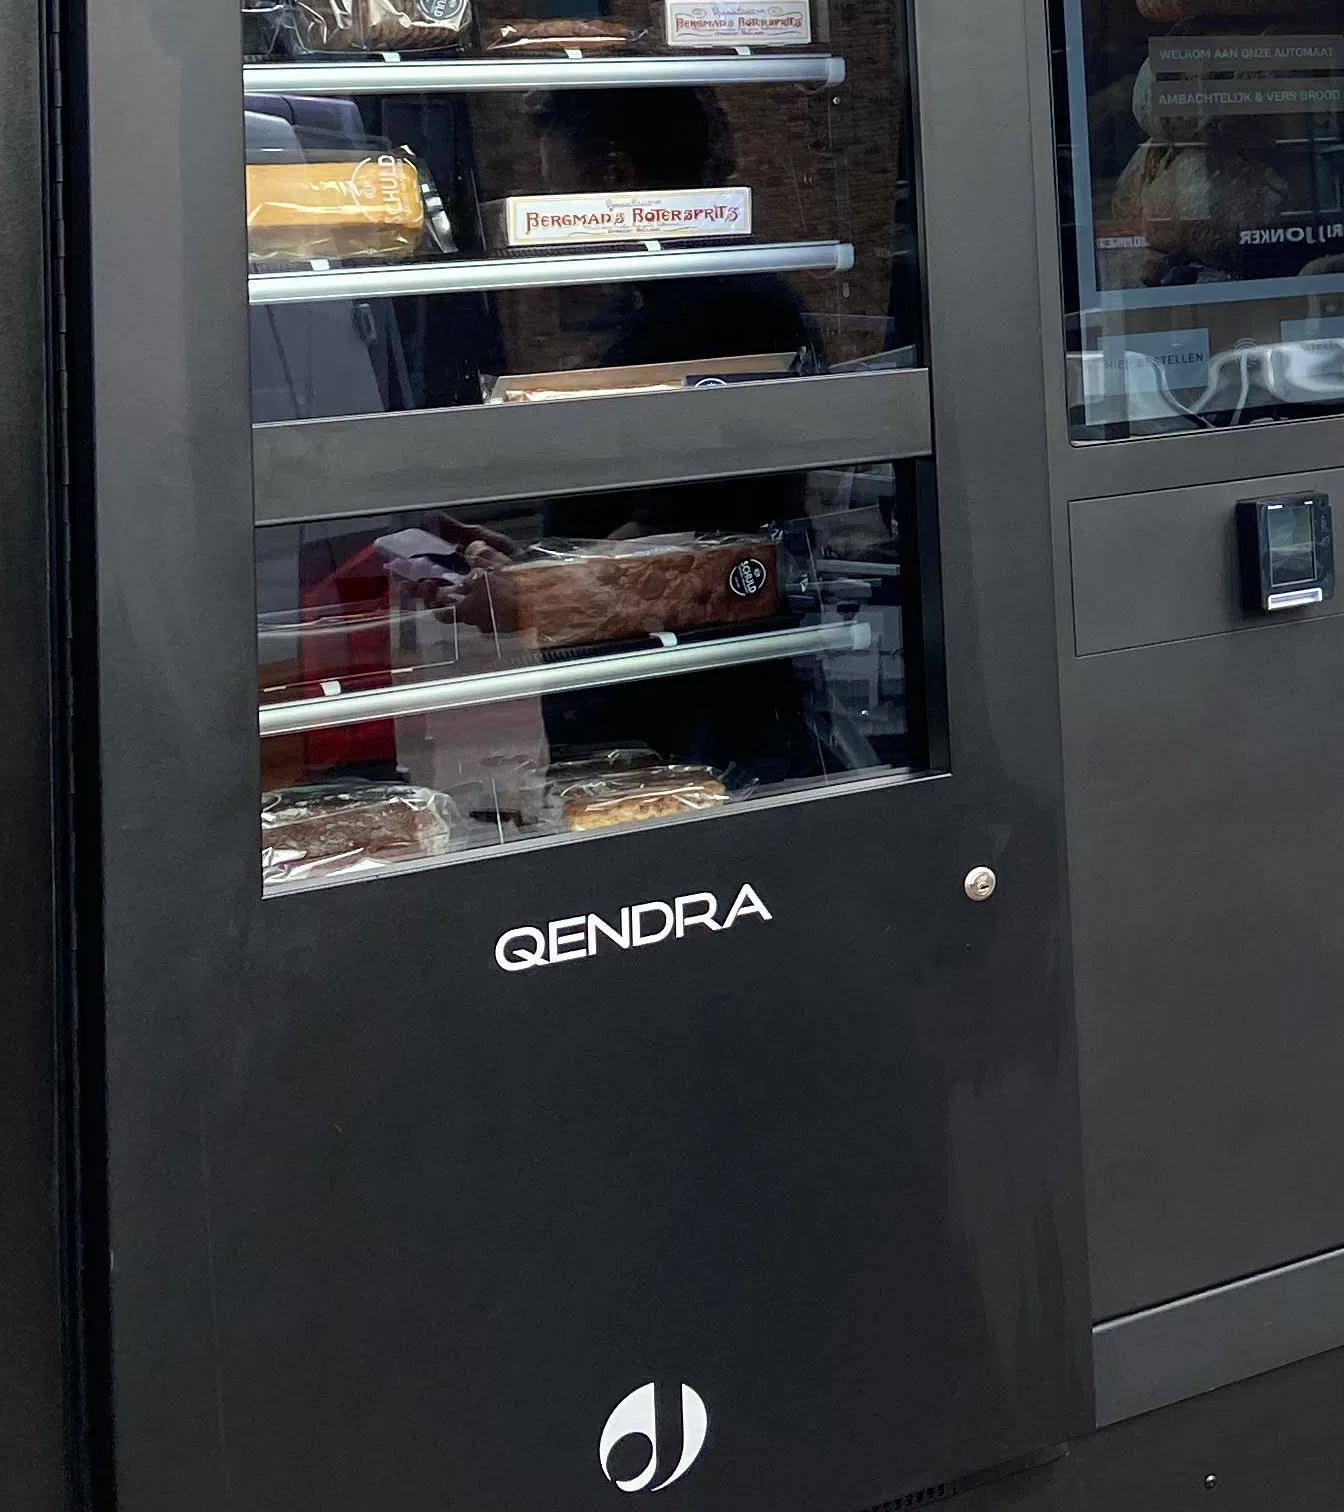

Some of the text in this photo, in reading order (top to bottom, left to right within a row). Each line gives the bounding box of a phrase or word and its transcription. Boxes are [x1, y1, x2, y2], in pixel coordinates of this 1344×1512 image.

[1159, 46, 1335, 61] WELKOM AAN ONZE AUTOMAAT
[1265, 90, 1297, 102] VERS
[1300, 89, 1341, 102] BROOD
[494, 883, 773, 971] QENDRA
